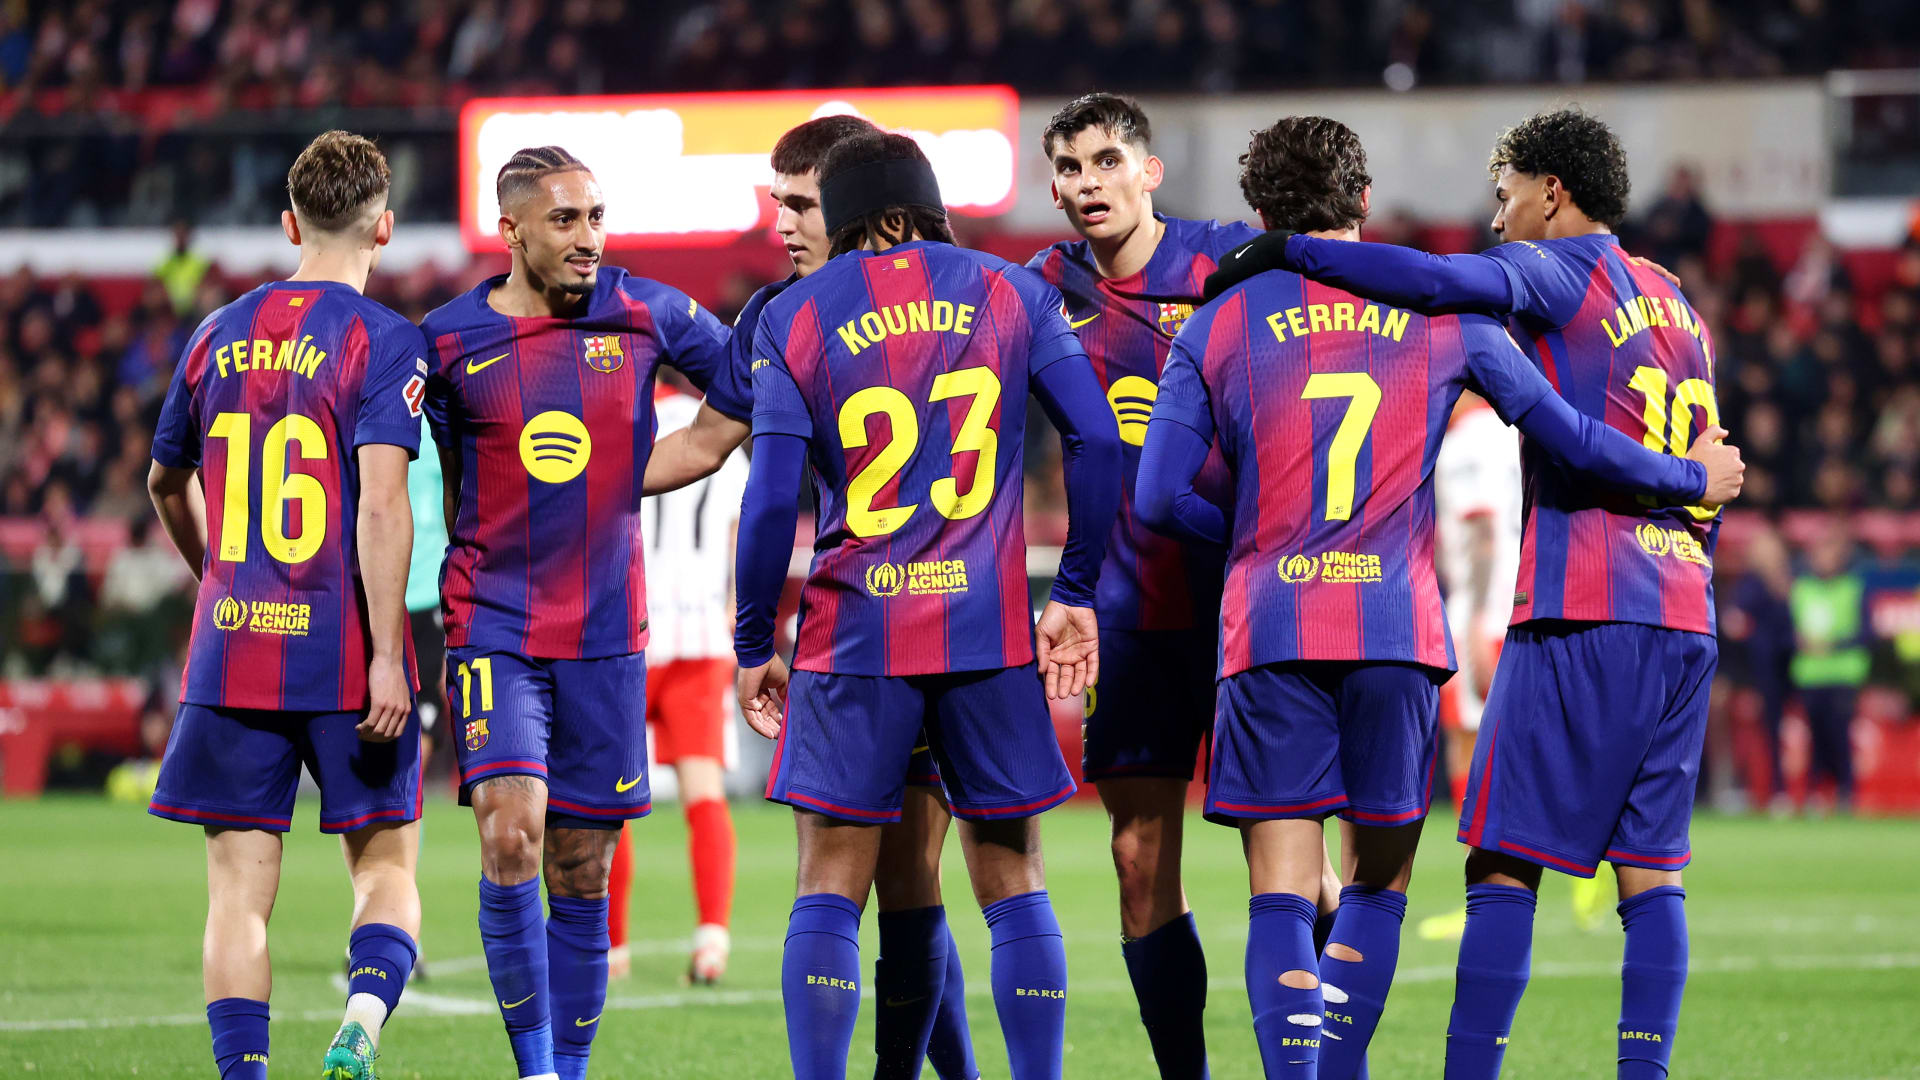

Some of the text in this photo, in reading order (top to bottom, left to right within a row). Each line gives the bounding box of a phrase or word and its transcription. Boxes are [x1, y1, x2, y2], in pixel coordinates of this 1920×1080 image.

[837, 300, 976, 356] KOUNDE
[1265, 302, 1411, 343] FERRAN
[215, 334, 327, 380] FERMÍN
[837, 365, 1002, 538] 23
[1300, 372, 1382, 521] 7
[1627, 365, 1723, 520] 10
[207, 412, 328, 564] 16
[1668, 528, 1702, 549] UNR
[907, 559, 966, 576] UNHCR
[1321, 551, 1381, 566] UNHCR
[1321, 564, 1382, 578] ACNUR
[907, 572, 968, 589] ACNUR
[249, 614, 310, 630] ACNUR
[251, 600, 311, 618] UNHCR
[457, 657, 493, 719] 11
[1016, 988, 1064, 999] BARÇA
